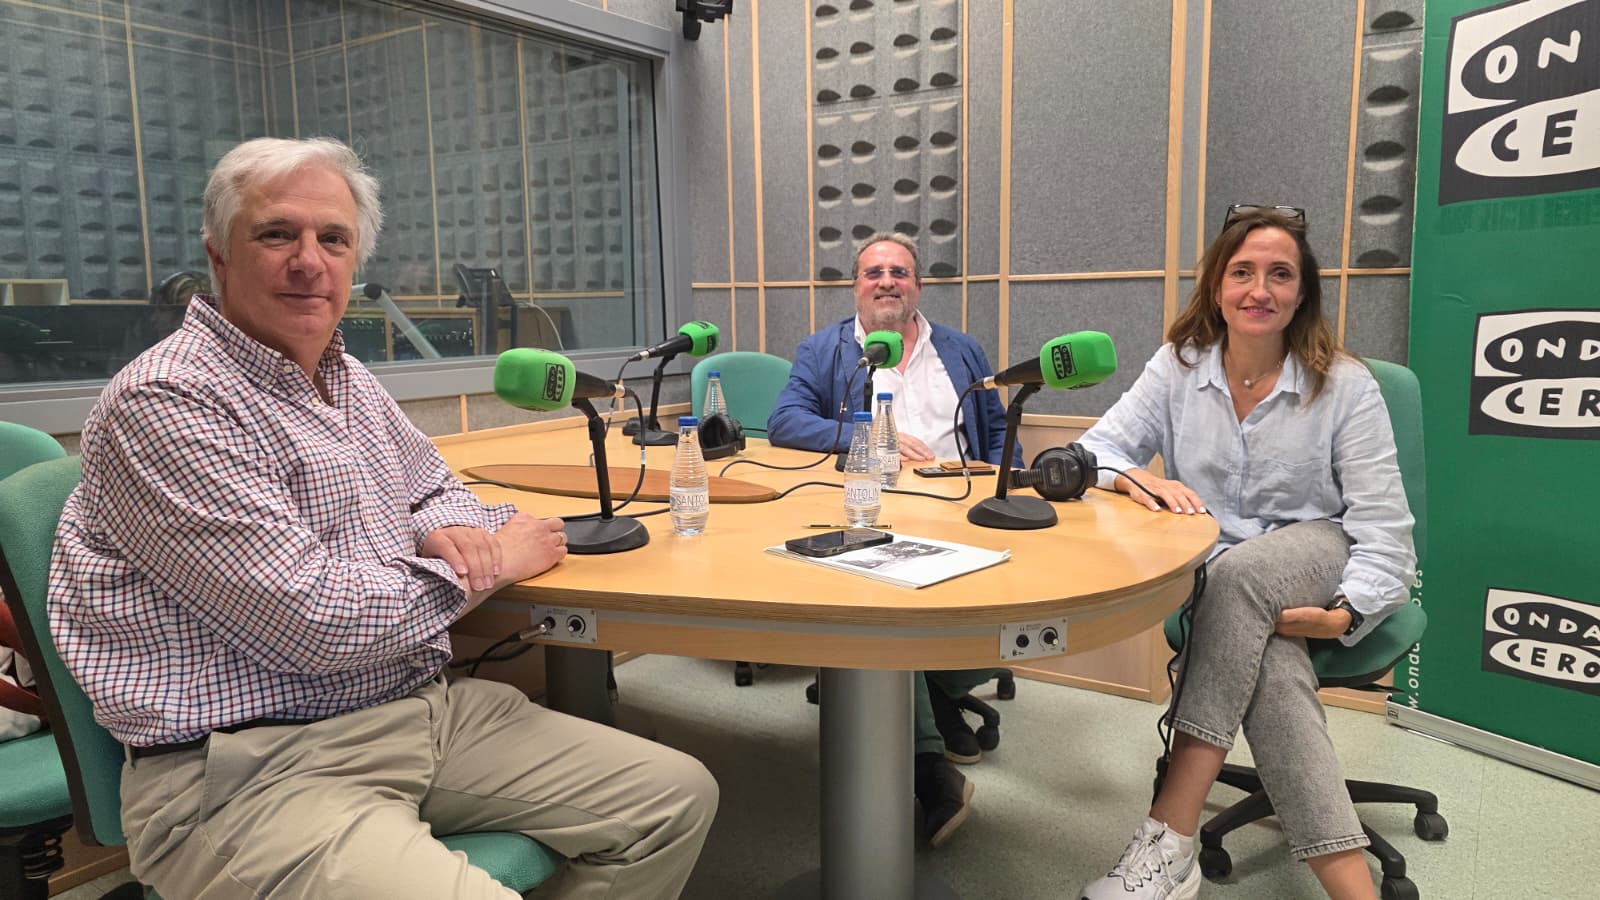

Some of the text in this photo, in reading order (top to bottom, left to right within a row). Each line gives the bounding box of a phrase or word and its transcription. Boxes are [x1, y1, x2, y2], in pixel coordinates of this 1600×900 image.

[1491, 109, 1578, 162] CE
[1504, 608, 1600, 641] ONDA
[1507, 643, 1600, 678] CERO
